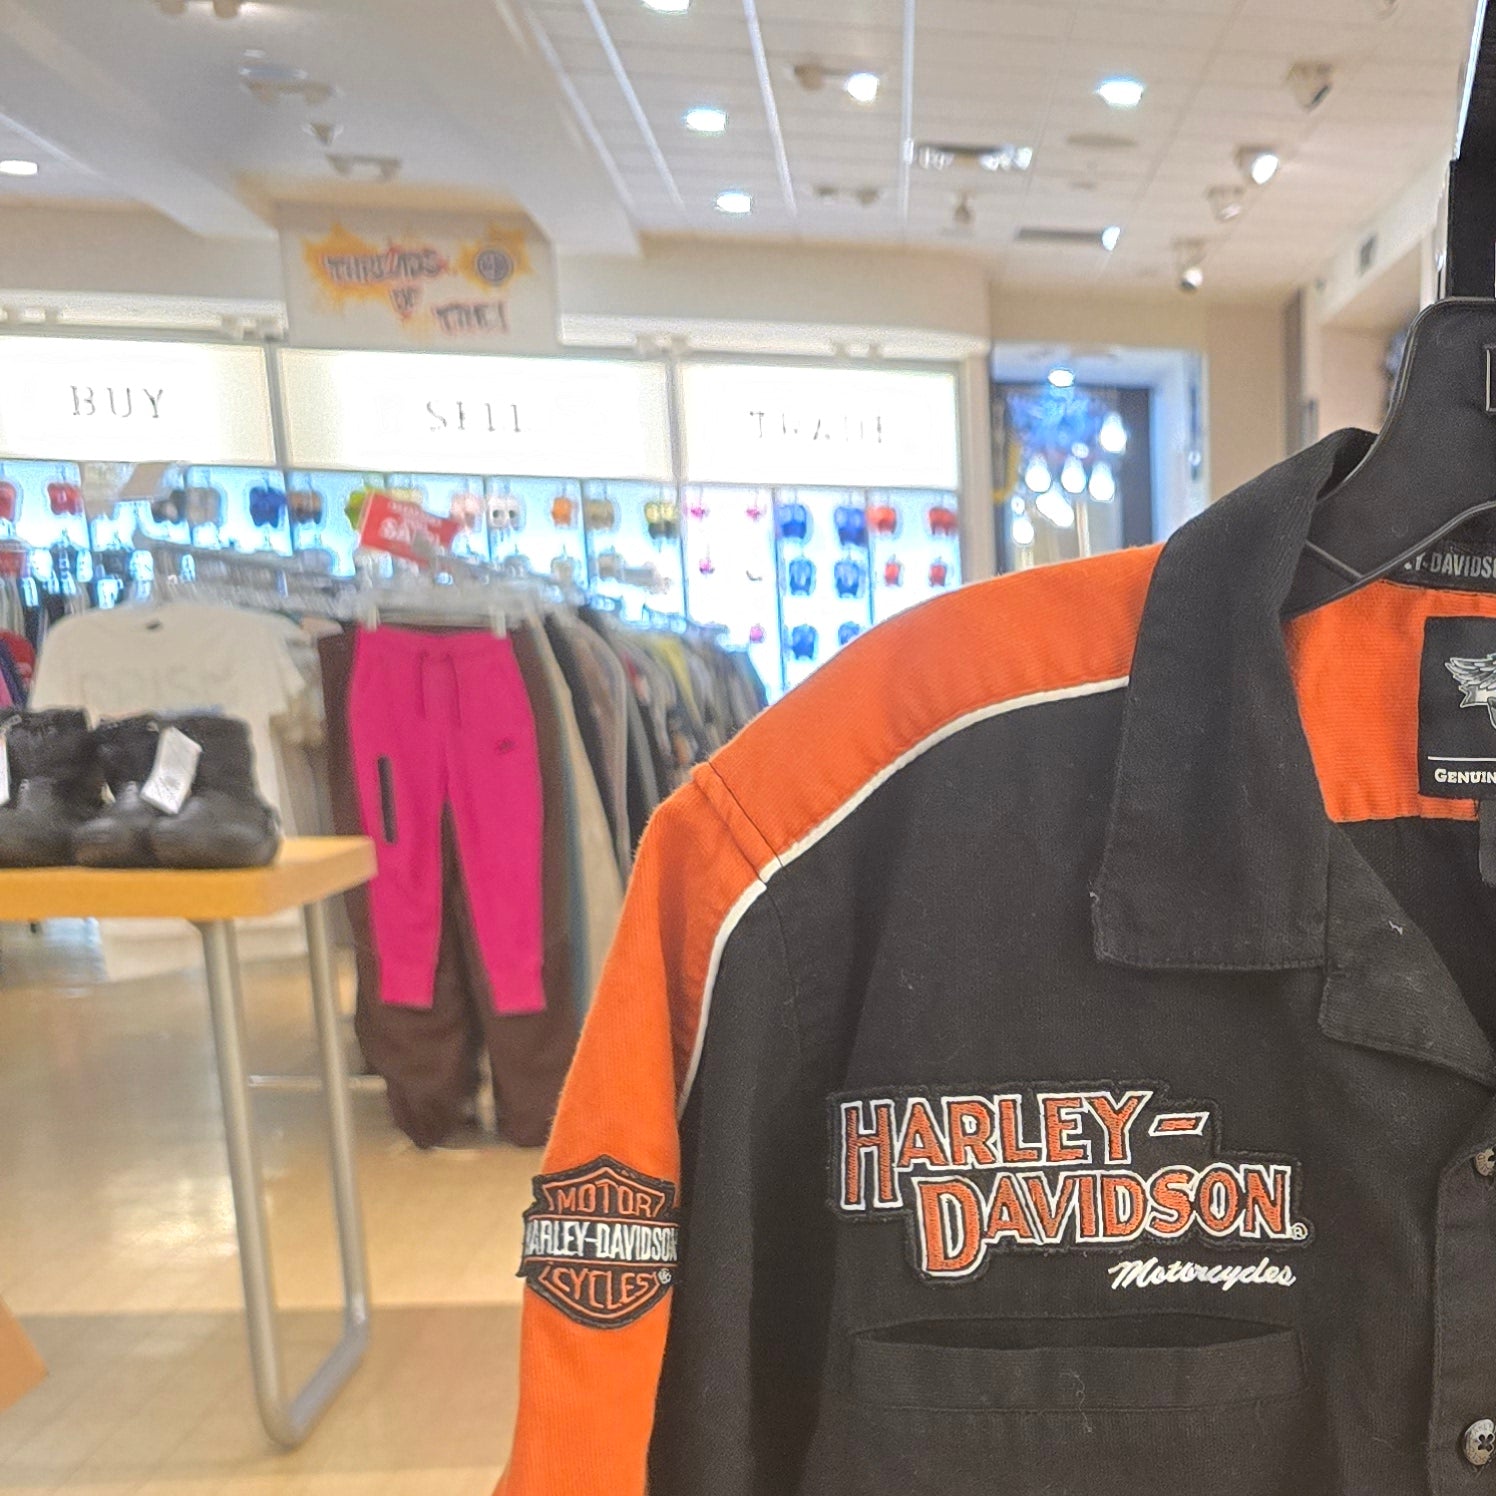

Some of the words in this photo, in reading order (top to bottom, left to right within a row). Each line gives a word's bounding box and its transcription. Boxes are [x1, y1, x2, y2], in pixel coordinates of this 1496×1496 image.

[70, 385, 163, 419] BUY
[557, 1180, 654, 1218] MOTOR
[552, 1267, 653, 1311] CYCLES
[1107, 1257, 1297, 1292] Motorcycles
